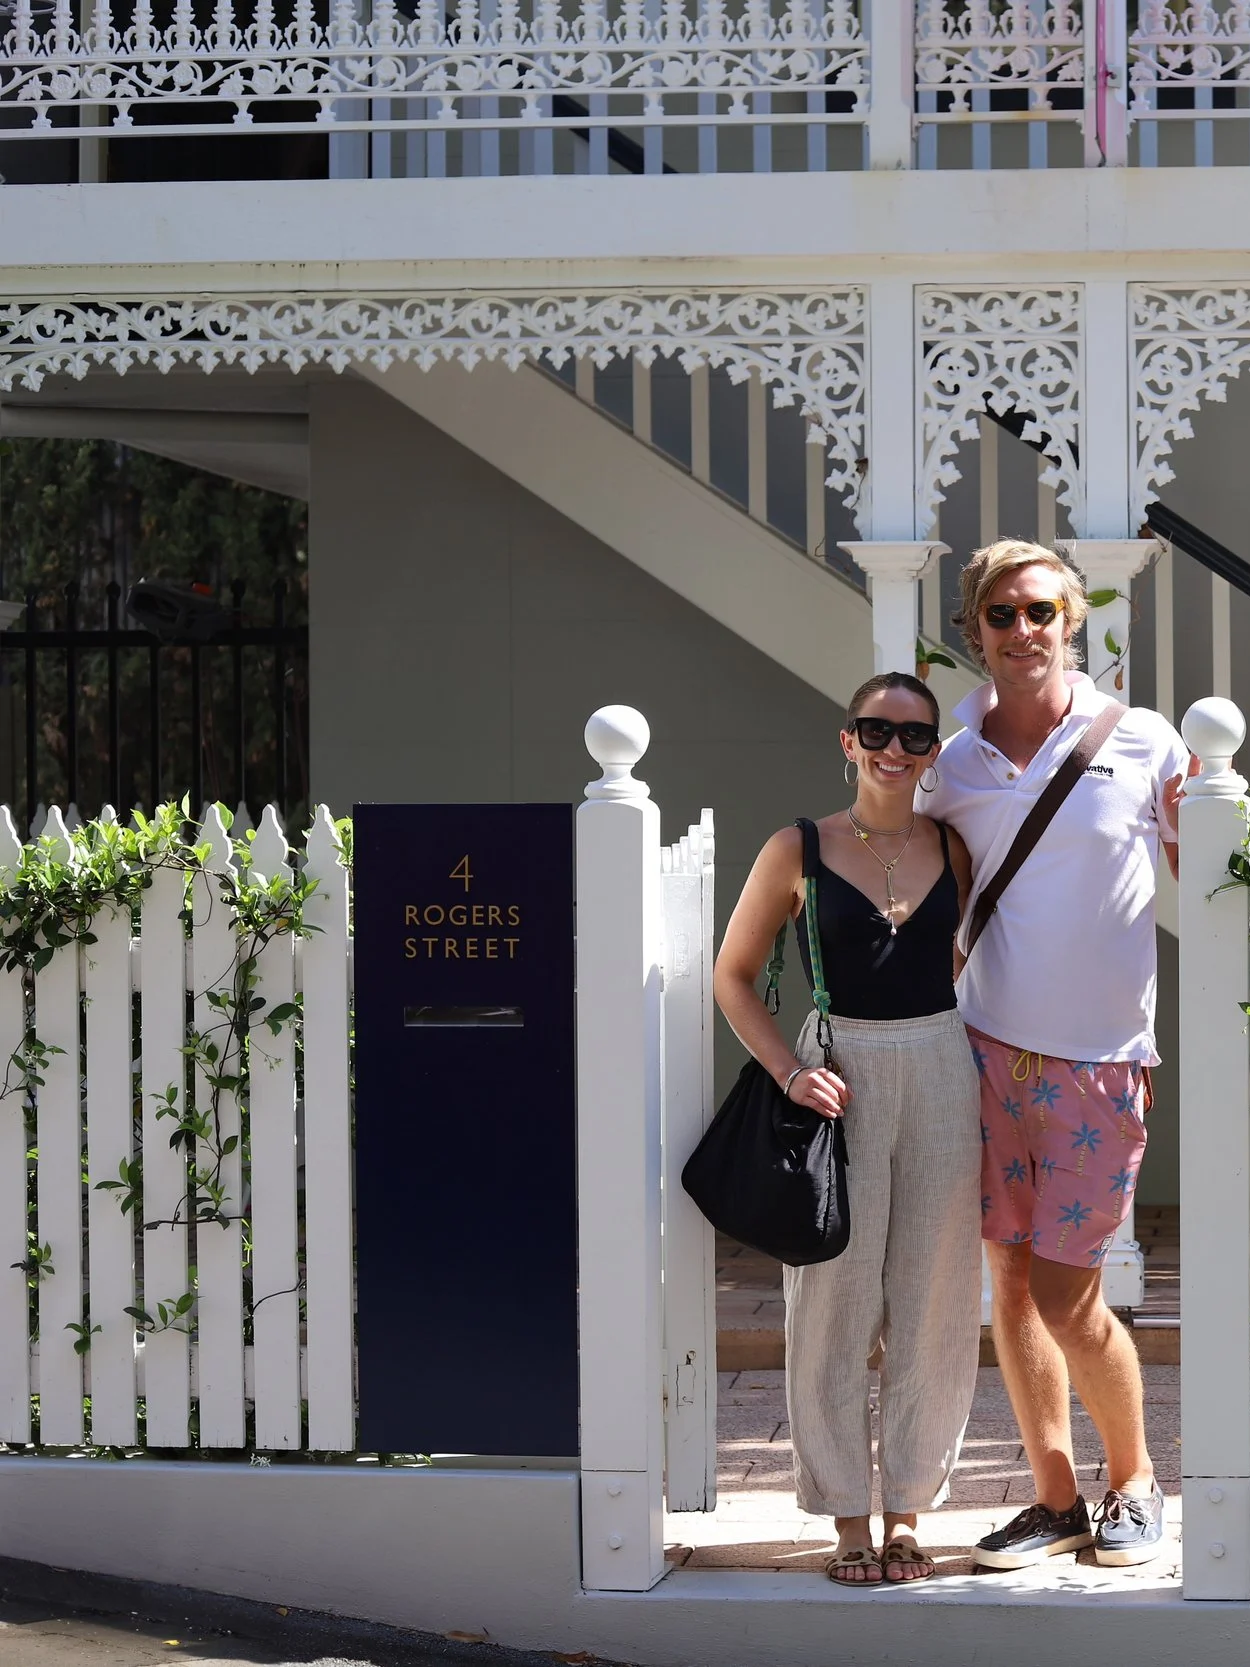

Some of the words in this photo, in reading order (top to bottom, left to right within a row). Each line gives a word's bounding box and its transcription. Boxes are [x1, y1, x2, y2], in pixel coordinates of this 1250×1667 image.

[449, 854, 474, 892] 4
[404, 904, 520, 926] ROGERS
[404, 938, 520, 959] STREET
